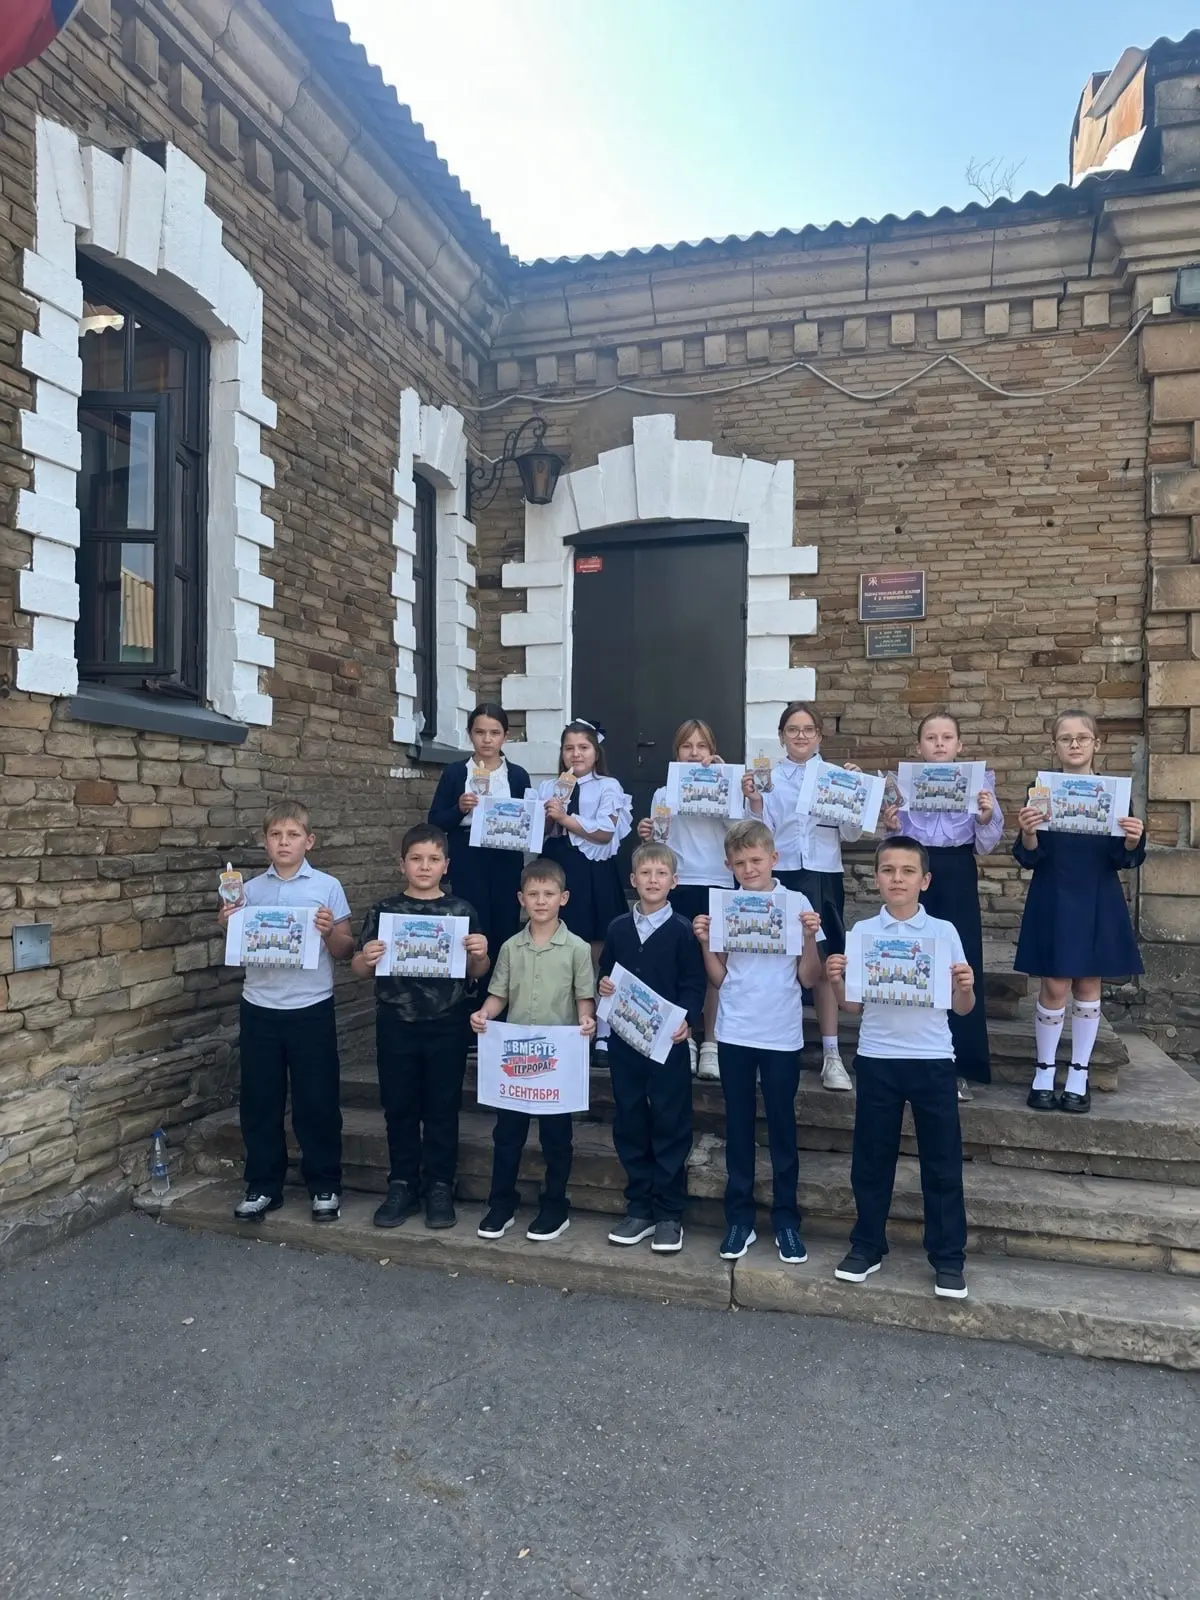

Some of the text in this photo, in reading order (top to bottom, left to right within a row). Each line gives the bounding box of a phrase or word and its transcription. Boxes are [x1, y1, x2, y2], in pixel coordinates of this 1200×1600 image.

[512, 1041, 555, 1056] ВМЕСТЕ
[500, 1083, 560, 1100] 3 СЕНТЯБРЯ
